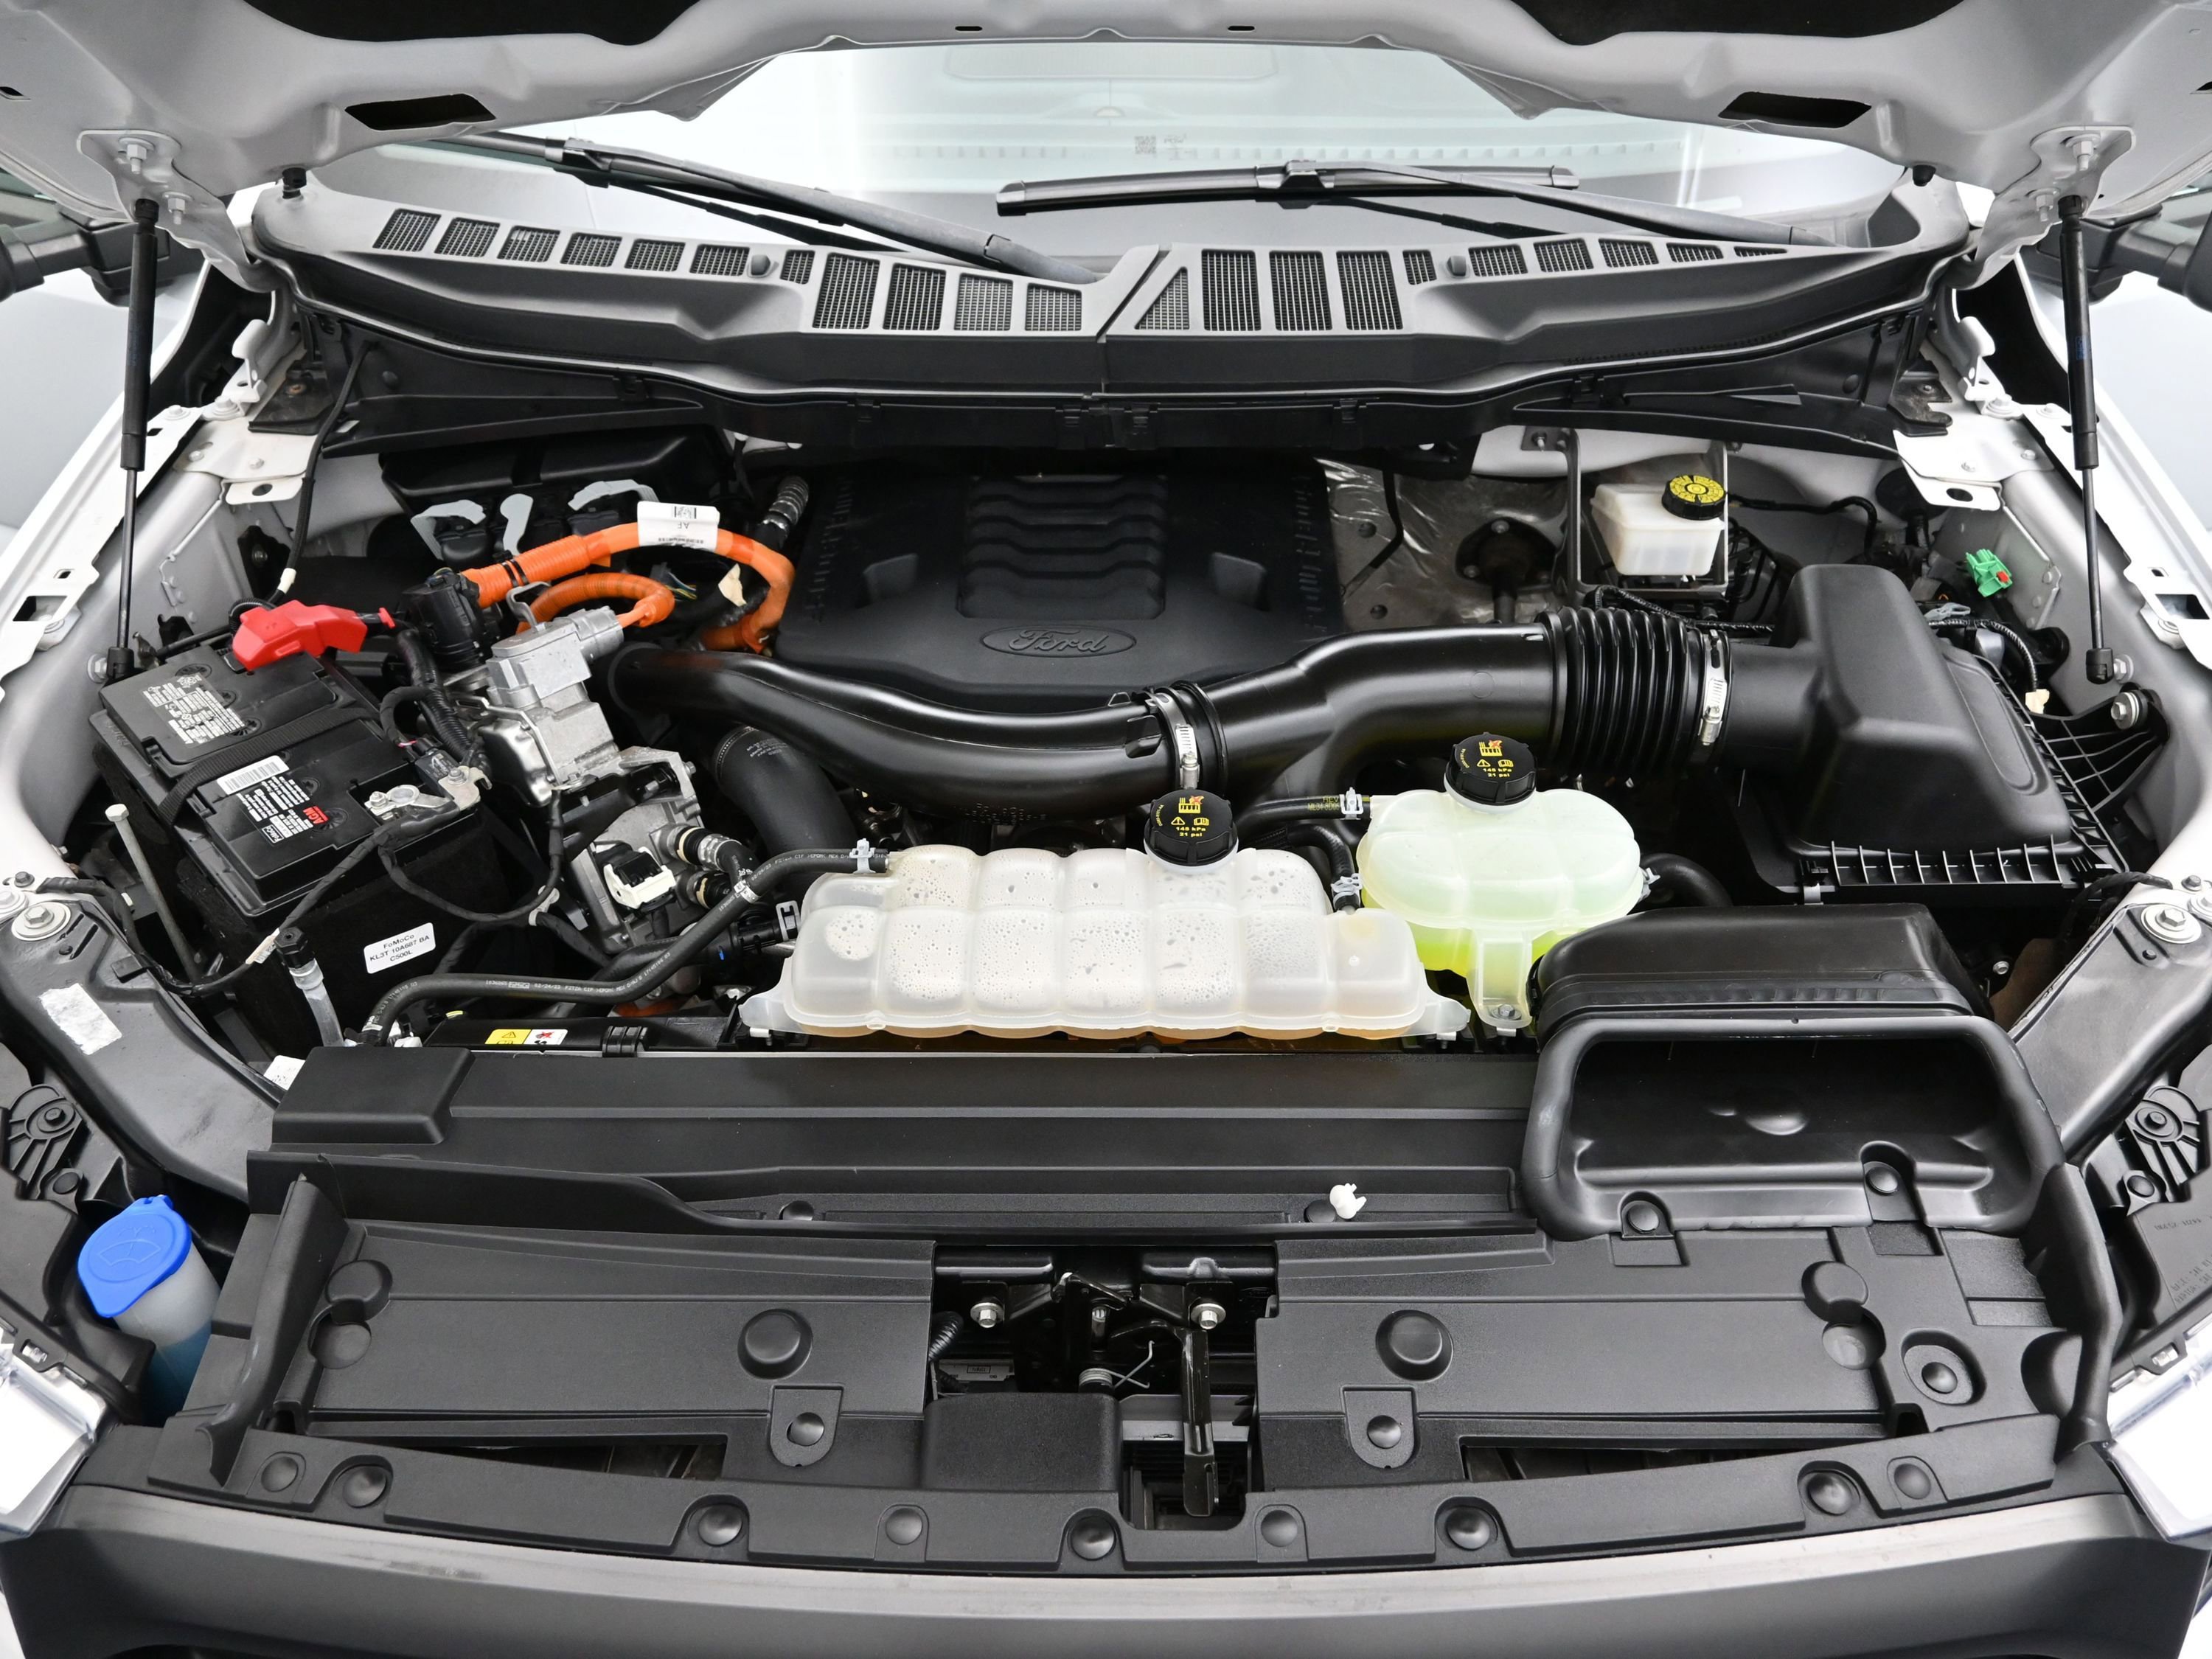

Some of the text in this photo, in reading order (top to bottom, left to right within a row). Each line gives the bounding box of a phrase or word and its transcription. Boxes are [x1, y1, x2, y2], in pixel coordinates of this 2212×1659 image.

[1009, 629, 1110, 653] Ford
[302, 806, 324, 824] AGM
[369, 935, 430, 961] KL3T 10A687 BA
[383, 934, 414, 949] FoMoCo
[389, 950, 414, 961] C500L
